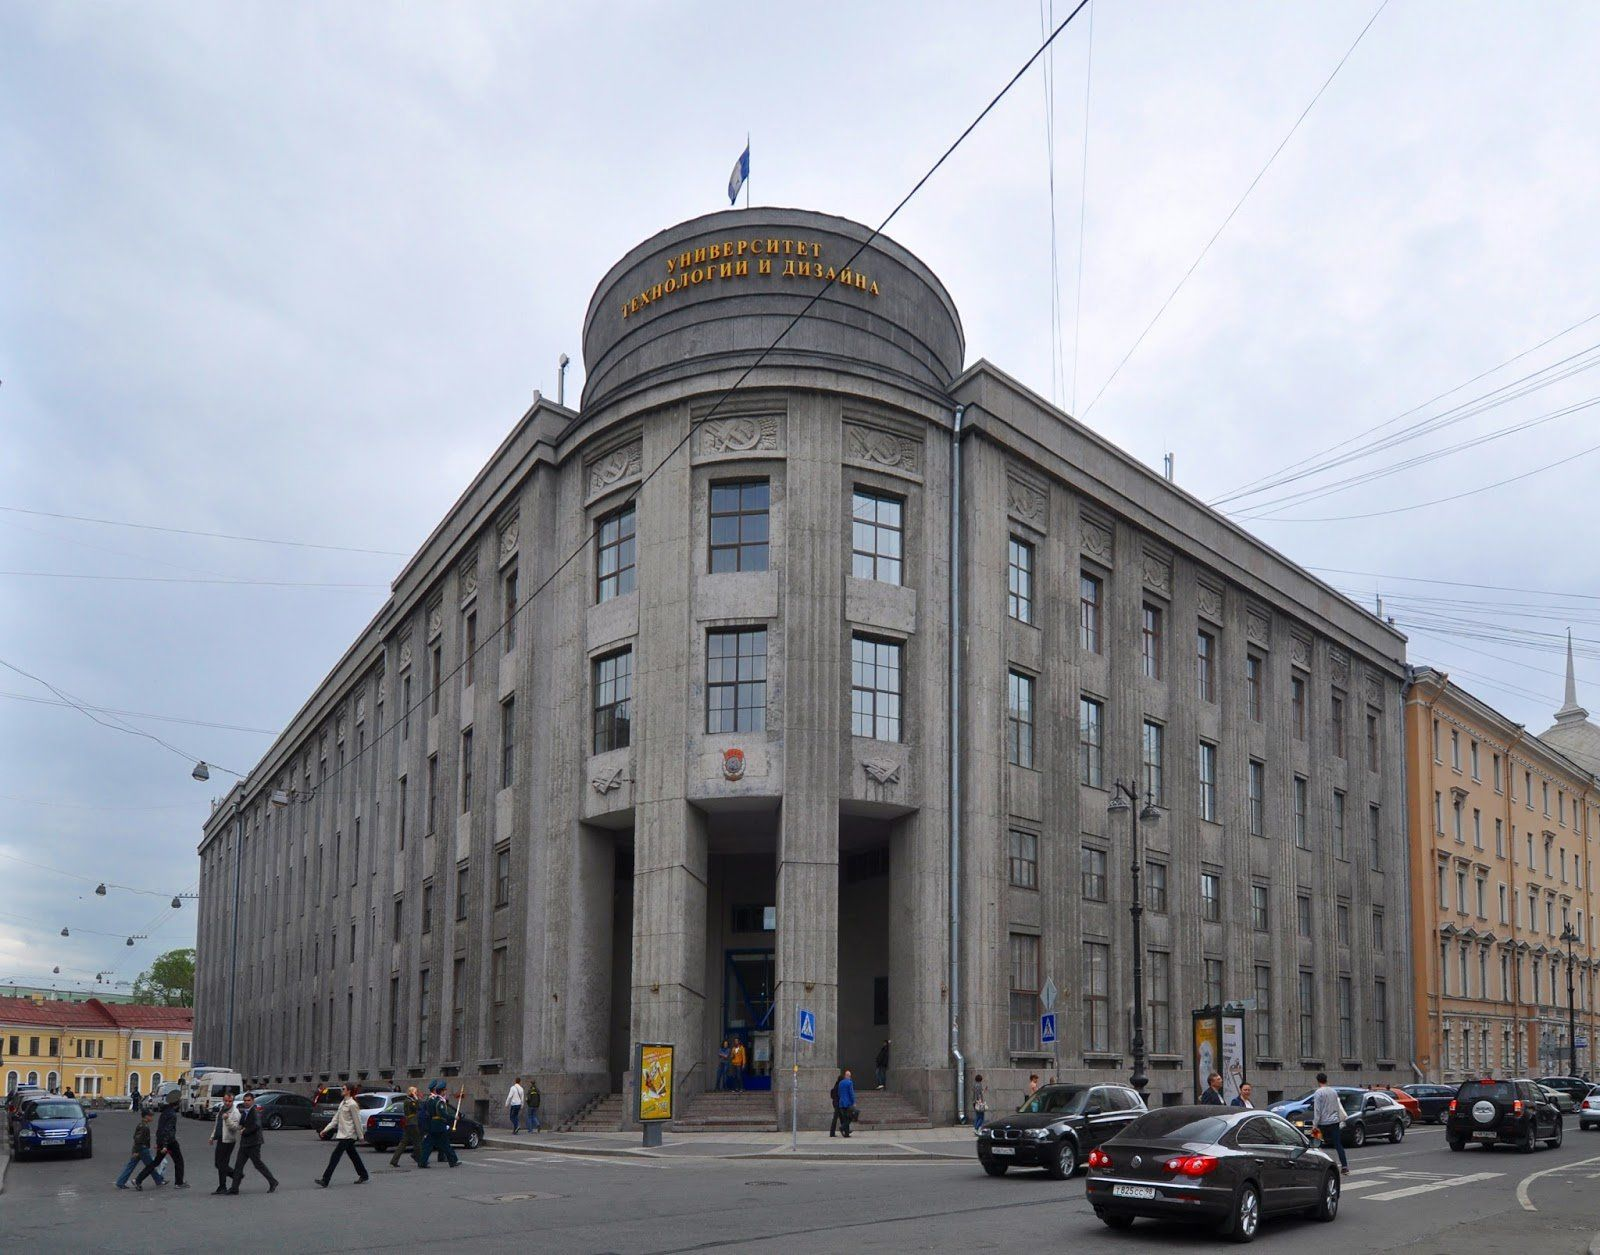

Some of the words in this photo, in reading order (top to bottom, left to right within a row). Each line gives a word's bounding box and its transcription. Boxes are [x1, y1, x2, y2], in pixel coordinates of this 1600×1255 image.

[667, 239, 822, 273] УНИВЕРСИТЕТ
[622, 260, 749, 319] ТЕХНОЛОГИИ
[758, 259, 772, 275] И
[782, 260, 880, 297] ДИЗАЙНА
